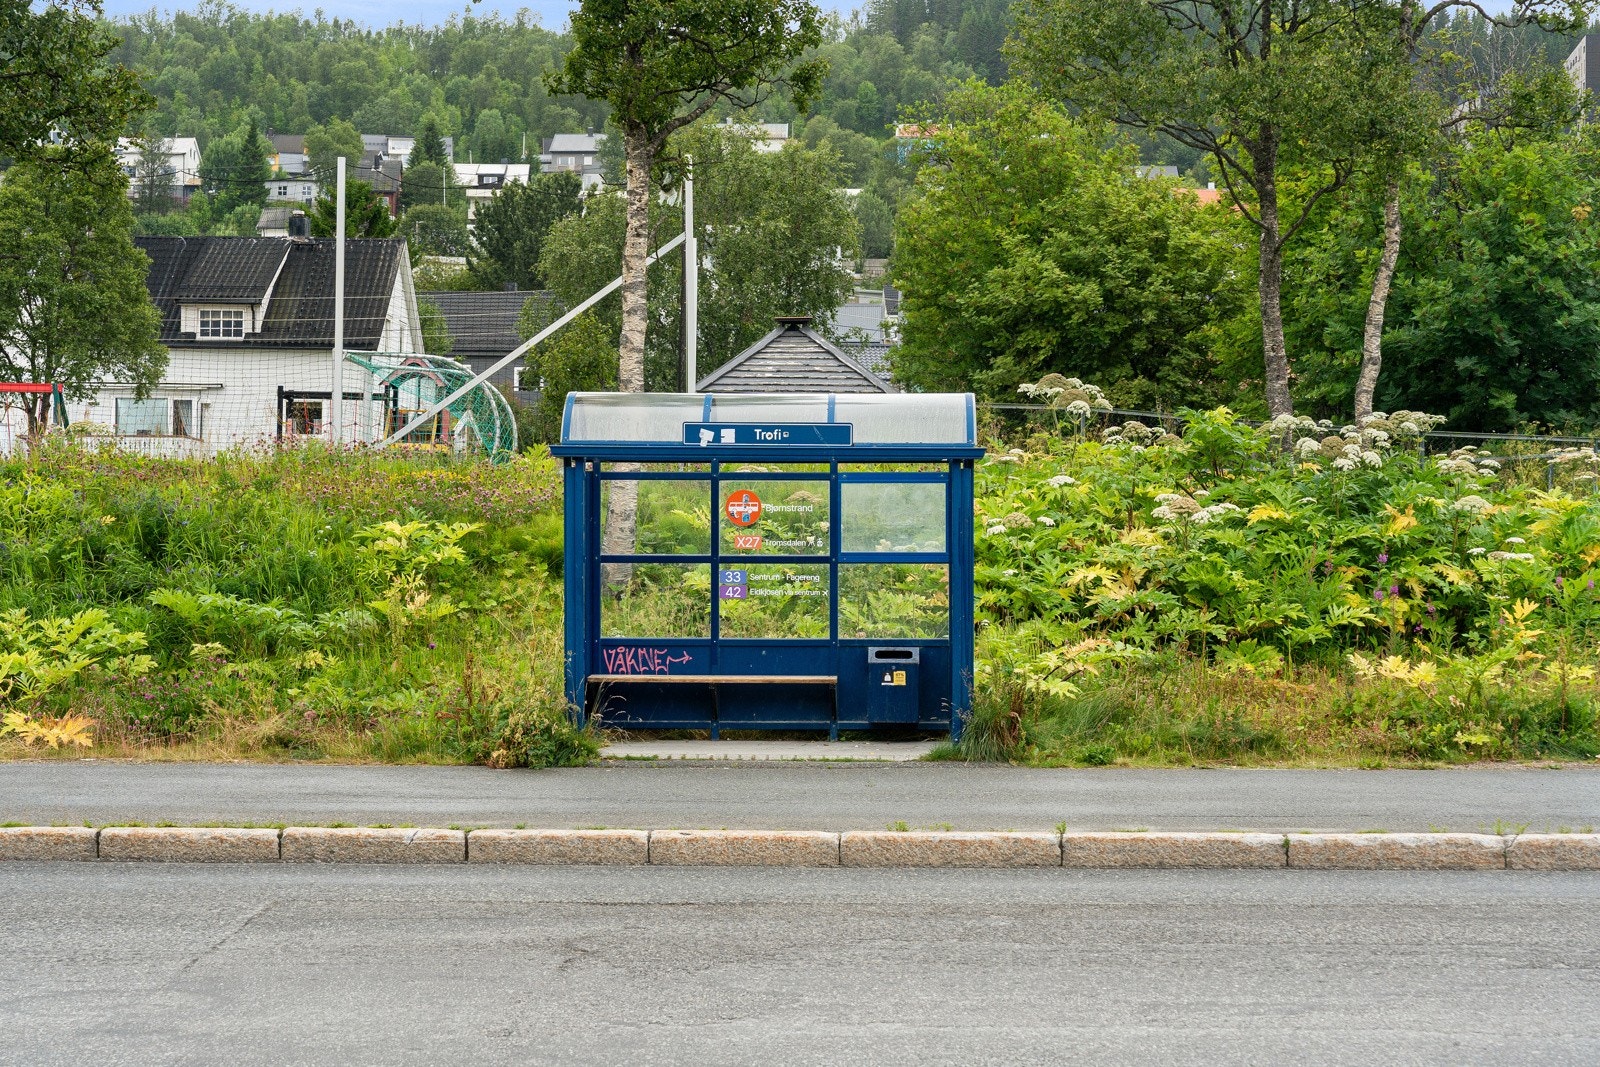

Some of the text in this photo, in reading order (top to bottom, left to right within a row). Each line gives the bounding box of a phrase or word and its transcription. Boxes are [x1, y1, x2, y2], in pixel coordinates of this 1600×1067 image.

[765, 504, 813, 513] Bjørnstrand
[736, 536, 760, 548] X27
[725, 571, 741, 583] 33
[749, 573, 780, 581] Sentrum
[725, 586, 741, 598] 42
[749, 588, 783, 597] Eidkjosen
